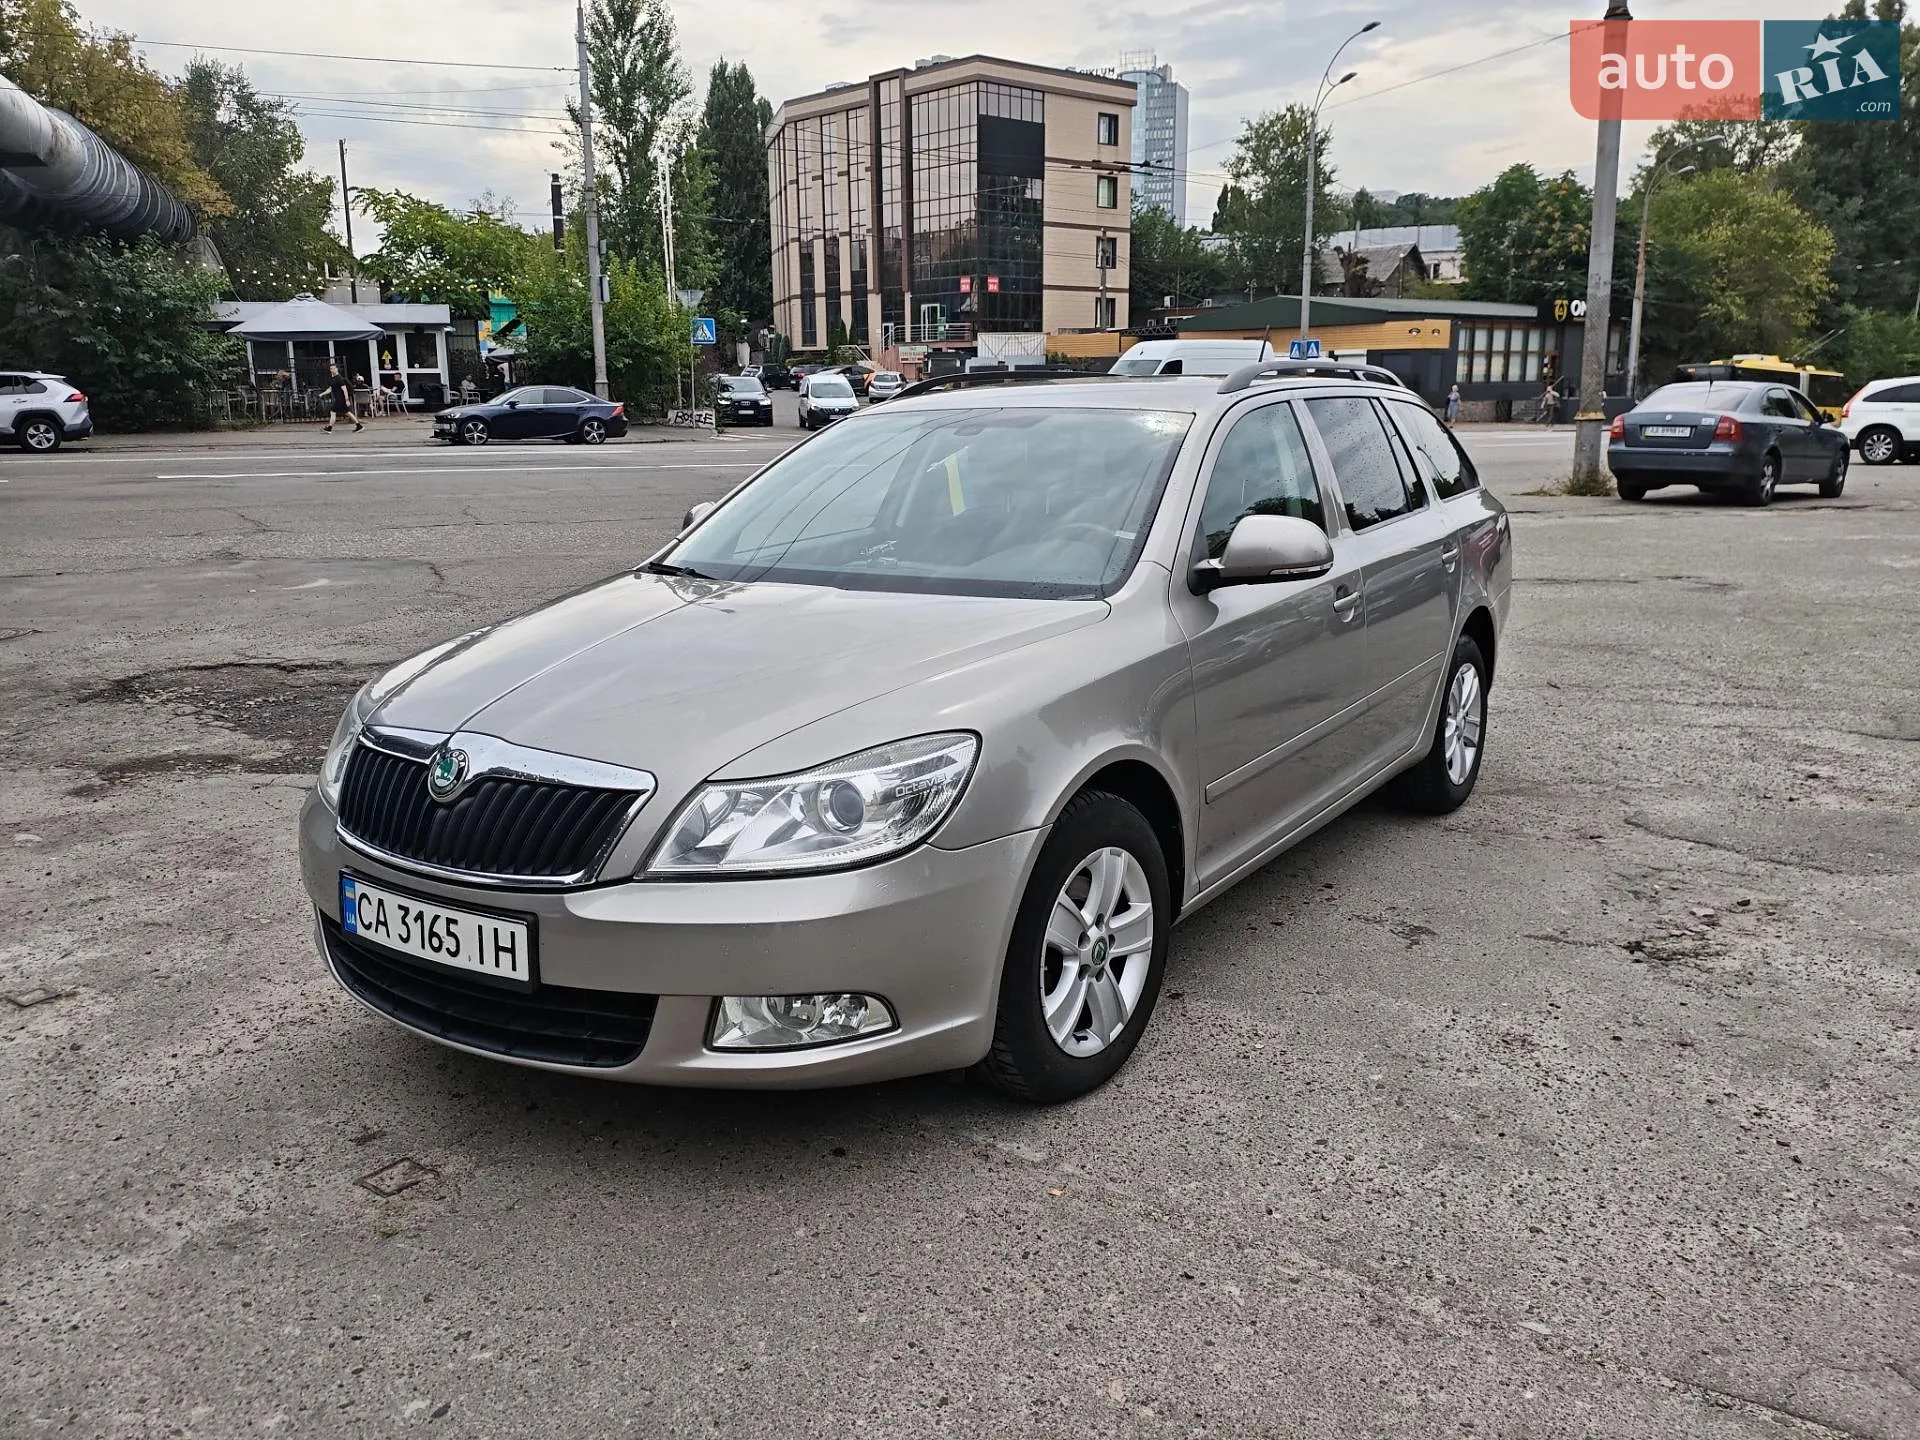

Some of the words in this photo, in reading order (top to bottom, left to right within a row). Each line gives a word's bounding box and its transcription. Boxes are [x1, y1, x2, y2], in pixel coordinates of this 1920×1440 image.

[346, 913, 356, 926] UA
[357, 891, 390, 938] CA
[397, 904, 461, 958] 3165
[477, 924, 518, 972] IH
